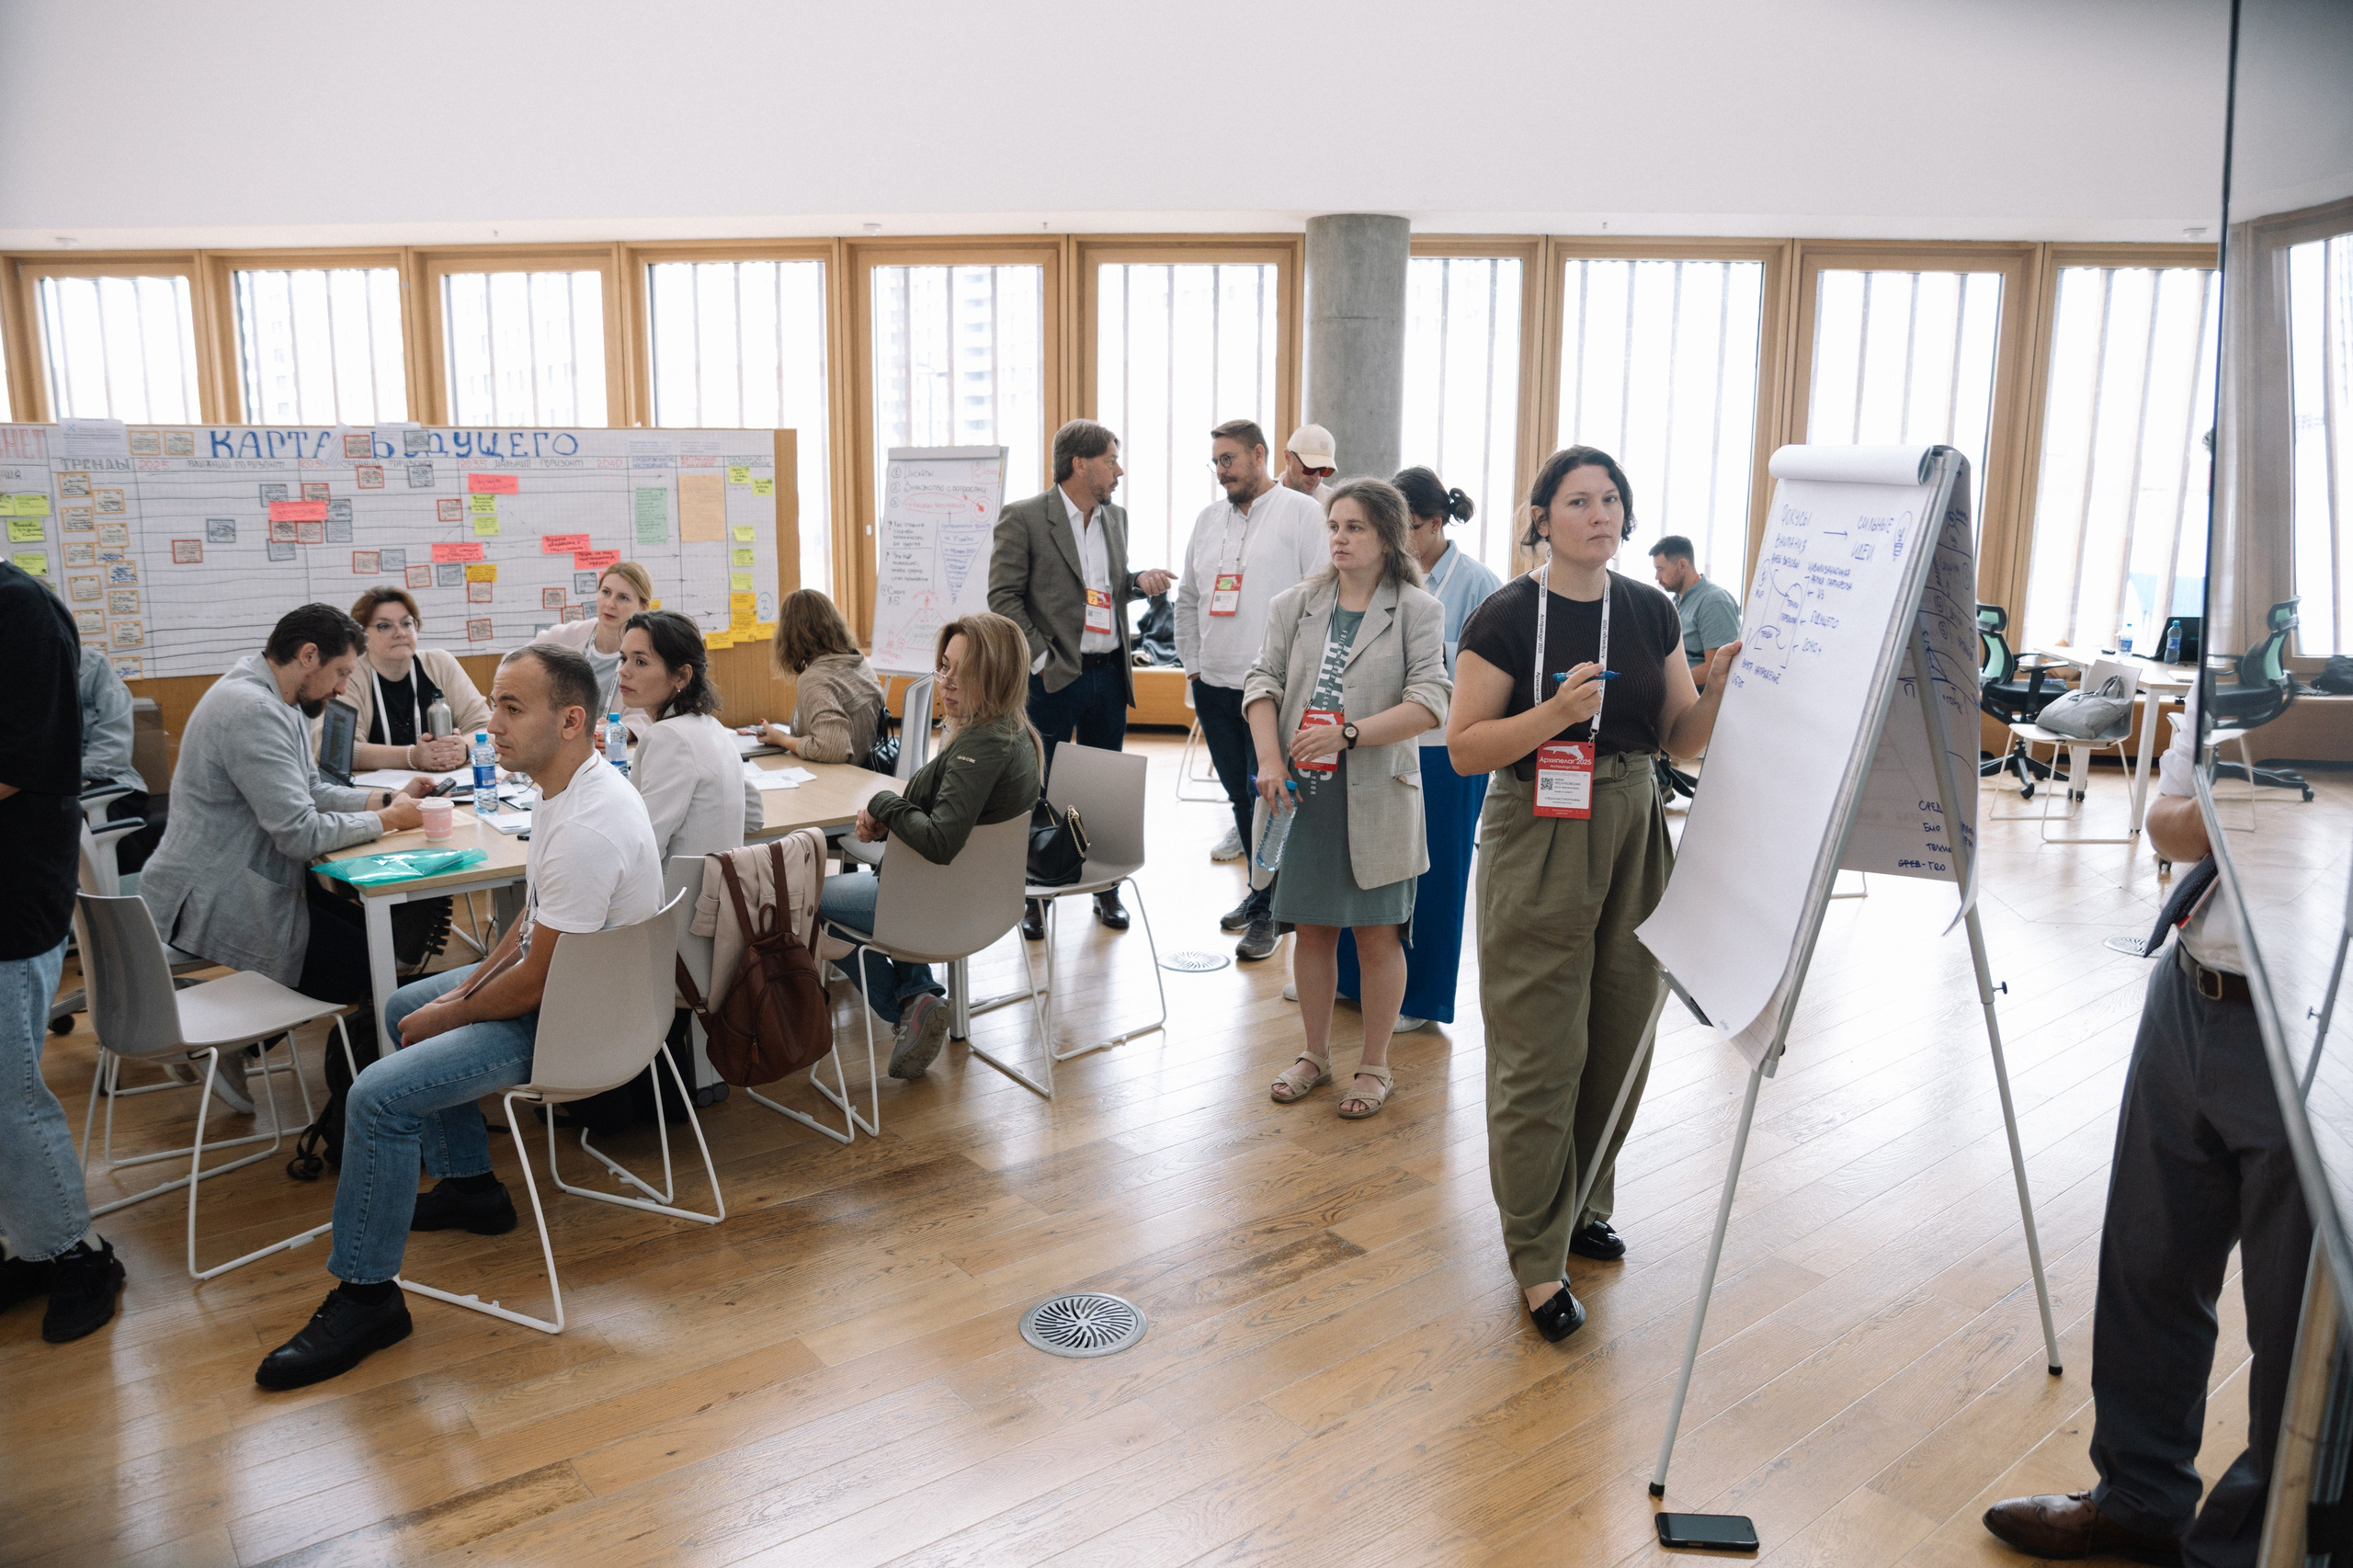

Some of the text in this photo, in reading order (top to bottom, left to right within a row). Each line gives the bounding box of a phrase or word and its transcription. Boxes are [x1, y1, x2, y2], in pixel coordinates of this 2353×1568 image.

[370, 431, 579, 460] БДУЩЕГО
[61, 459, 131, 471] ТРЕНДЫ
[139, 460, 170, 471] 2025
[460, 460, 488, 469] 2035
